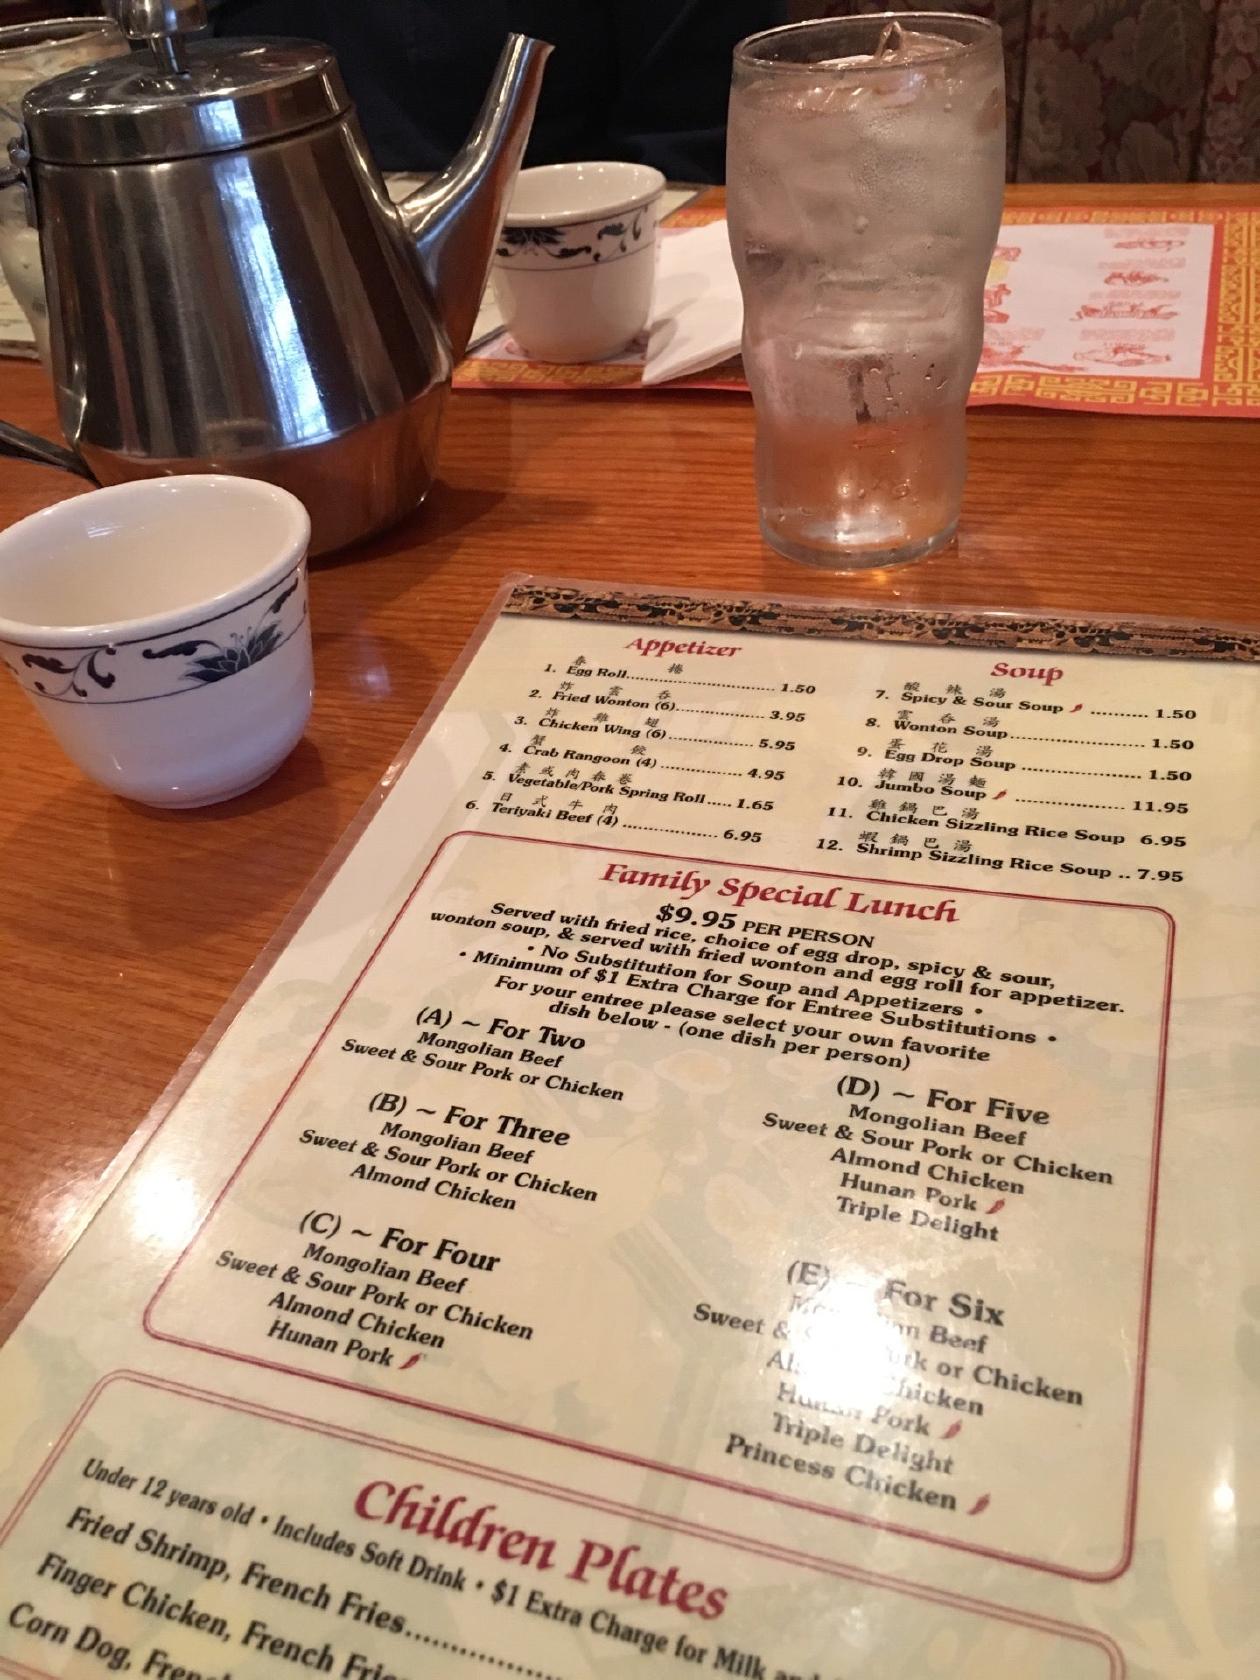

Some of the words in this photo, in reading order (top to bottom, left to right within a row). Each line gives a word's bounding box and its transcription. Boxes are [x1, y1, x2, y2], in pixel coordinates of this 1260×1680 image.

[625, 637, 743, 658] Appetizer
[543, 663, 556, 673] 1.
[565, 665, 593, 678] Egg
[596, 667, 627, 679] Roll
[781, 683, 817, 695] 1.50
[990, 662, 1064, 687] Soup
[528, 689, 542, 699] 2.
[551, 690, 591, 704] Fried
[595, 695, 650, 709] Wonton
[654, 701, 676, 712] (6)
[769, 710, 806, 723] 3.95
[875, 689, 889, 700] 7.
[900, 691, 948, 706] Spicy
[951, 695, 967, 706] &
[972, 696, 1013, 709] Sour
[1017, 700, 1064, 715] Soup
[1157, 708, 1197, 720] 1.50
[513, 715, 527, 726] 3.
[538, 717, 599, 733] Chicken
[604, 723, 641, 739] Wing
[645, 728, 667, 740] (6)
[758, 738, 796, 751] 5.95
[865, 717, 881, 728] 8.
[893, 719, 957, 735] Wonton
[962, 725, 1009, 740] Soup
[1152, 738, 1195, 751] 1.50
[499, 743, 512, 753] 4.
[523, 745, 560, 758] Crab
[562, 749, 631, 766] Rangoon
[635, 757, 657, 769] (4)
[747, 767, 785, 781] 4.95
[857, 746, 872, 757] 9.
[884, 749, 916, 763] Egg
[920, 752, 965, 768] Drop
[969, 756, 1017, 772] Soup
[1149, 769, 1193, 782] 1.50
[481, 770, 496, 781] 5.
[507, 773, 615, 795] Vegetable/Pork
[618, 785, 669, 803] Spring
[672, 791, 706, 804] Roll
[736, 798, 775, 811] 1.65
[837, 775, 863, 788] 10.
[873, 779, 935, 795] Jumbo
[940, 785, 987, 801] Soup
[1133, 800, 1189, 815] 11.95
[465, 800, 479, 810] 6.
[492, 801, 553, 819] Teriyaki
[555, 809, 594, 824] Beef
[596, 815, 619, 828] (4)
[723, 829, 763, 843] 6.95
[828, 806, 853, 819] 11.
[865, 809, 939, 828] Chicken
[945, 817, 1019, 837] Sizzling
[1024, 825, 1069, 839] Rice
[1074, 829, 1125, 846] Soup
[1139, 834, 1187, 848] 6.95
[815, 838, 843, 852] 12.
[856, 842, 923, 862] Shrimp
[927, 849, 1005, 870] Sizzling
[1009, 857, 1054, 873] Rice
[1059, 862, 1112, 880] Soup
[1137, 868, 1184, 883] 7.95
[600, 863, 711, 901] Family
[716, 877, 843, 909] Special
[843, 892, 960, 923] Lunch
[490, 902, 557, 922] Served
[559, 913, 600, 929] with
[604, 918, 651, 936] fried
[653, 926, 697, 944] rice,
[703, 933, 771, 952] choice
[776, 942, 801, 956] of
[802, 948, 840, 964] egg
[844, 949, 900, 971] drop,
[906, 961, 967, 979] spicy
[971, 965, 993, 981] &
[999, 972, 1055, 990] sour,
[655, 903, 739, 930] $9.95
[741, 920, 783, 937] PER
[786, 926, 875, 949] PERSON
[471, 950, 564, 977] Minimum
[569, 966, 593, 980] of
[593, 967, 620, 985] $1
[625, 973, 679, 993] Extra
[686, 982, 760, 1007] Charge
[765, 993, 797, 1011] for
[801, 998, 873, 1022] Entree
[879, 1010, 1037, 1044] Substitutions
[415, 1006, 453, 1030] (A)
[486, 1017, 531, 1041] For
[537, 1025, 586, 1050] Two
[416, 1031, 515, 1061] Mongolian
[518, 1048, 565, 1069] Beef
[341, 1038, 397, 1060] Sweet
[399, 1049, 418, 1063] &
[421, 1052, 468, 1073] Sour
[470, 1060, 515, 1082] Pork
[519, 1074, 541, 1086] or
[545, 1074, 625, 1101] Chicken
[368, 1092, 408, 1118] (B)
[442, 1105, 489, 1131] For
[496, 1114, 571, 1146] Three
[836, 1075, 880, 1103] (D)
[926, 1088, 977, 1114] For
[985, 1097, 1050, 1125] Five
[839, 1171, 915, 1199] Hunan
[925, 1186, 977, 1211] Pork
[299, 1209, 342, 1240] (C)
[379, 1227, 429, 1257] For
[432, 1238, 501, 1272] Four
[836, 1195, 901, 1222] Triple
[909, 1209, 999, 1242] Delight
[267, 1291, 355, 1327] Almond
[357, 1312, 445, 1349] Chicken
[883, 1278, 939, 1313] For
[948, 1293, 1004, 1327] Six
[773, 1412, 845, 1445] Triple
[855, 1435, 953, 1474] Delight
[725, 1433, 833, 1479] Princess
[845, 1466, 956, 1511] Chicken
[66, 1506, 135, 1545] Fried
[135, 1528, 231, 1582] Shrimp,
[240, 1561, 331, 1611] French
[337, 1591, 405, 1634] Fries
[82, 1457, 139, 1490] Under
[141, 1476, 168, 1499] 12
[165, 1489, 218, 1515] years
[220, 1502, 257, 1526] old
[273, 1515, 356, 1558] Includes
[360, 1541, 404, 1573] Soft
[407, 1555, 466, 1592] Drink
[491, 1578, 519, 1607] $1
[525, 1590, 583, 1628] Extra
[590, 1610, 668, 1655] Charge
[674, 1634, 707, 1664] for
[712, 1647, 766, 1680] Milk
[354, 1480, 557, 1572] Children
[566, 1539, 729, 1620] Plates
[36, 1552, 117, 1599] Finger
[122, 1581, 231, 1642] Chicken,
[241, 1619, 335, 1673] French
[9, 1603, 70, 1645] Corn
[73, 1625, 131, 1671] Dog,
